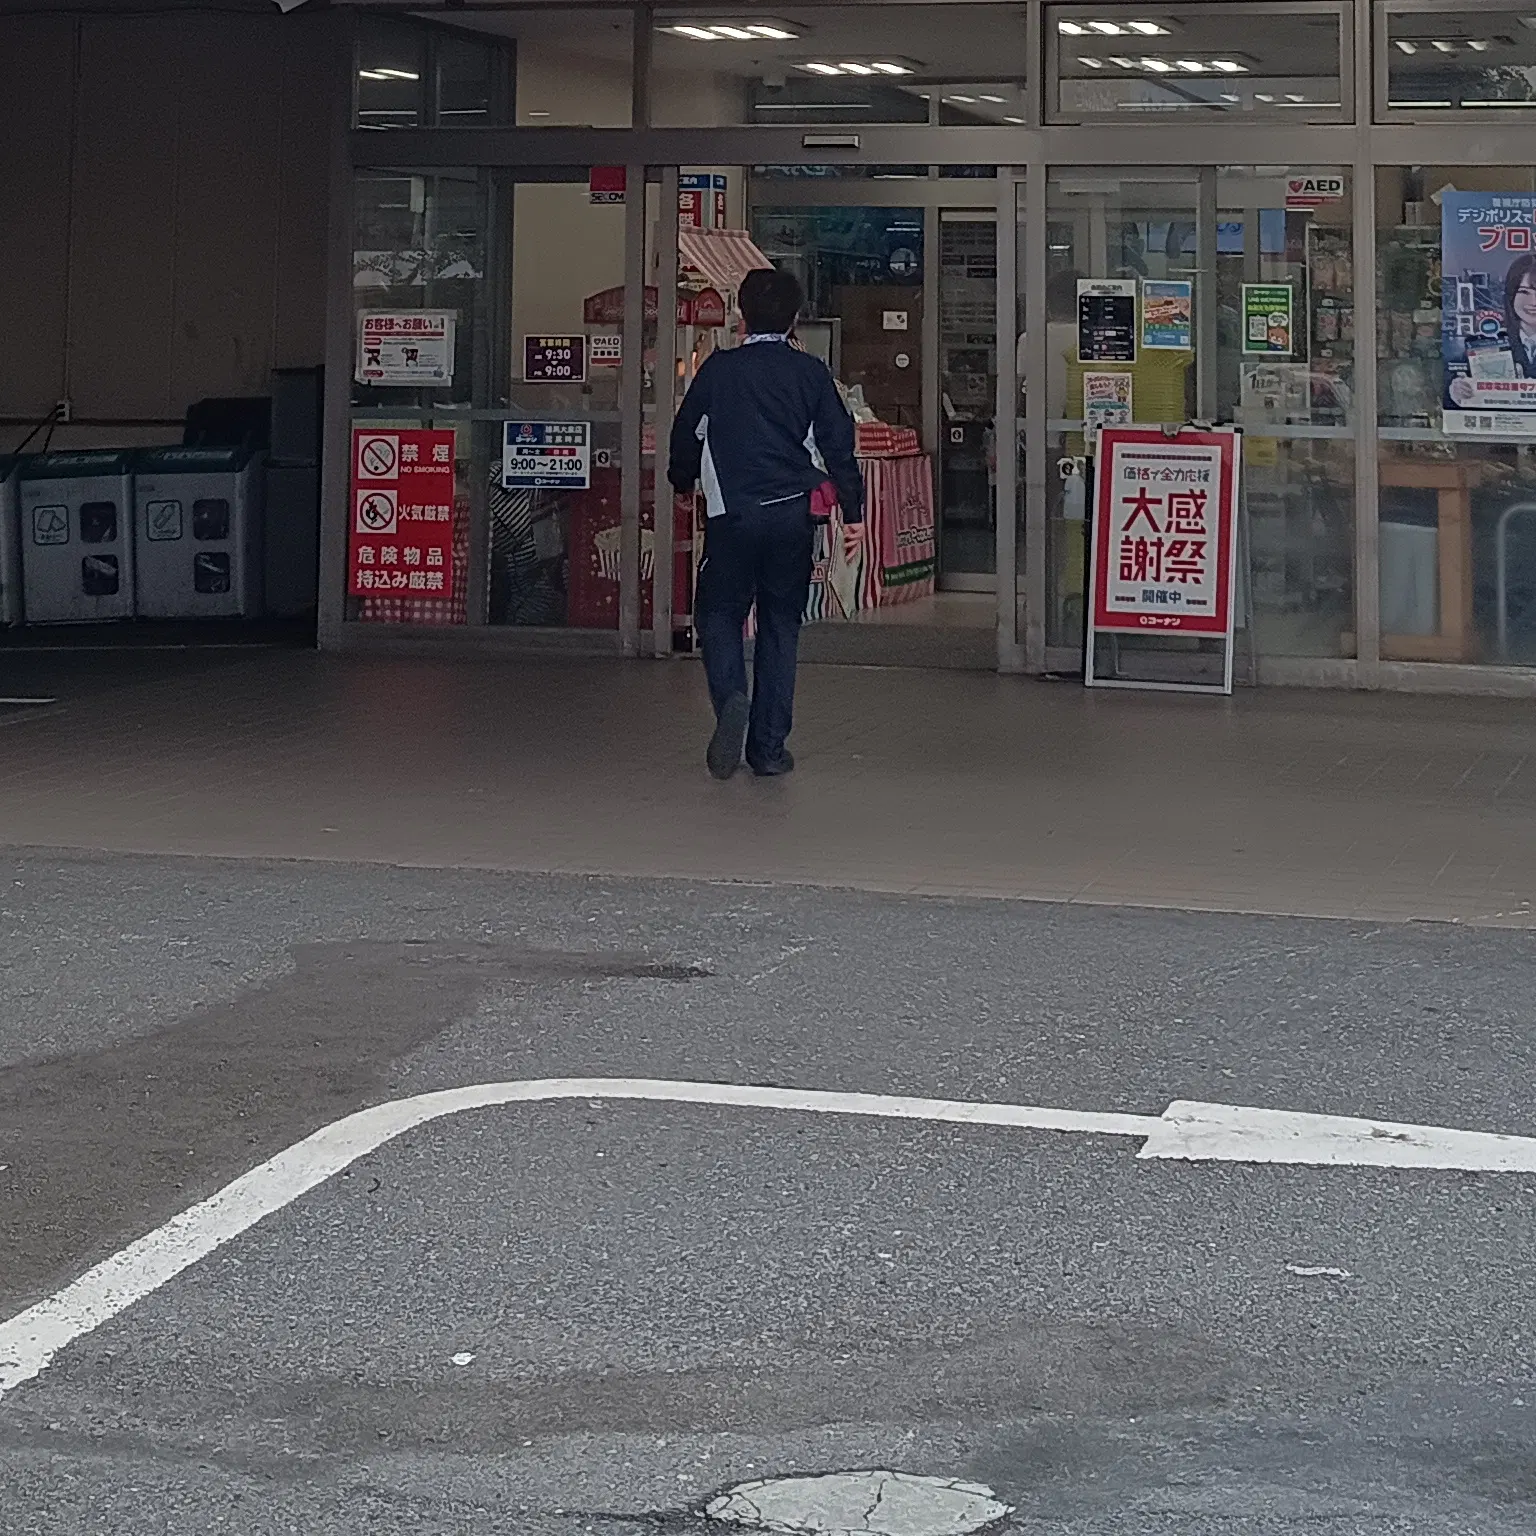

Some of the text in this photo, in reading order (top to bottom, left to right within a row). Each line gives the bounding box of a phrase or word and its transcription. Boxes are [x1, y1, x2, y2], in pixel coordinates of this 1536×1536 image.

[1303, 180, 1341, 192] AED
[591, 192, 625, 202] SECOM
[545, 349, 571, 360] 9:30
[545, 365, 571, 376] 9:00
[401, 444, 450, 462] 禁煙
[400, 466, 450, 474] NO SMOKING
[398, 504, 450, 522] 火気厳禁
[358, 545, 443, 566] 危険物品
[356, 569, 444, 590] 持込み厳禁
[1142, 589, 1182, 604] 開催中
